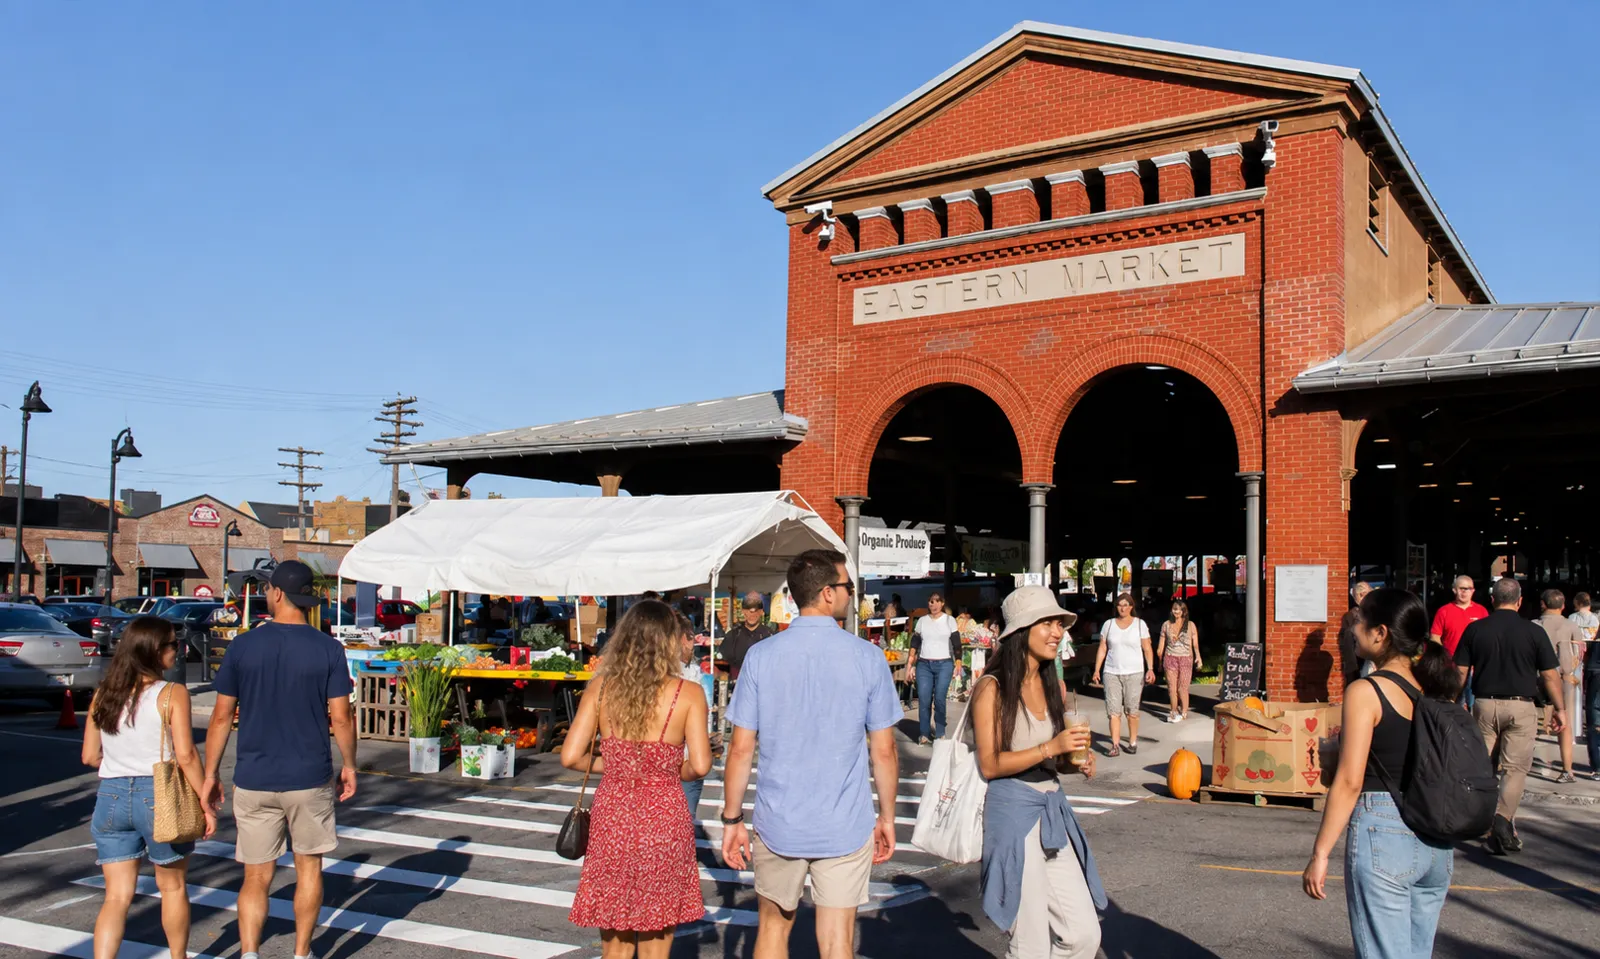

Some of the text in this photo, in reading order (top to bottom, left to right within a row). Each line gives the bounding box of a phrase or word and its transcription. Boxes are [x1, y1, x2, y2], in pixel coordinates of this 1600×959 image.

[863, 241, 1232, 317] EASTERN MARKET
[862, 532, 926, 550] Organic Produce
